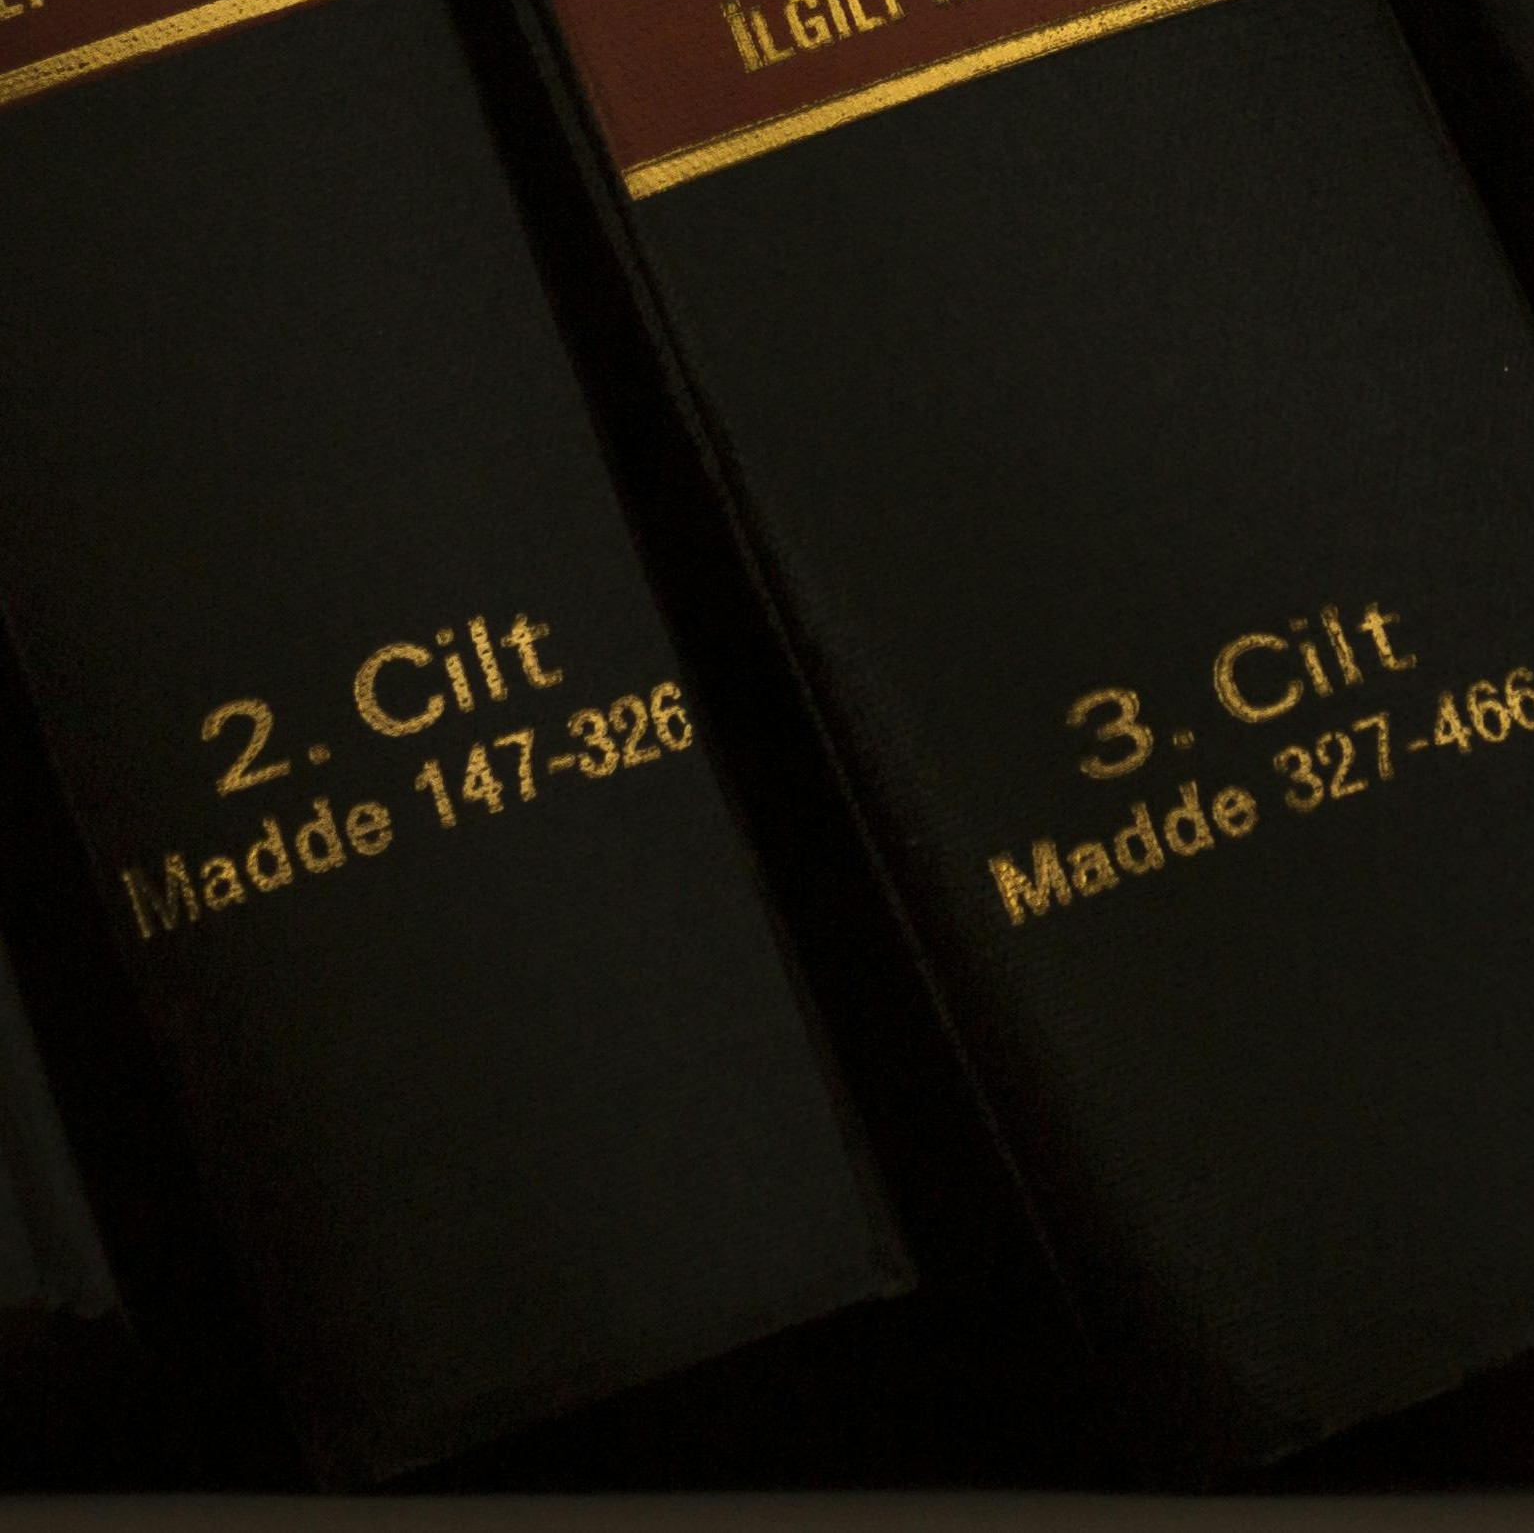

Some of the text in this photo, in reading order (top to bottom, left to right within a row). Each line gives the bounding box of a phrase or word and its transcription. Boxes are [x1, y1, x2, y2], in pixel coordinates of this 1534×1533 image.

[201, 613, 562, 797] 2. Cilt
[1066, 600, 1417, 780] 3. Cilt
[119, 680, 693, 940] Madde 147-326
[987, 780, 1261, 927] Madde
